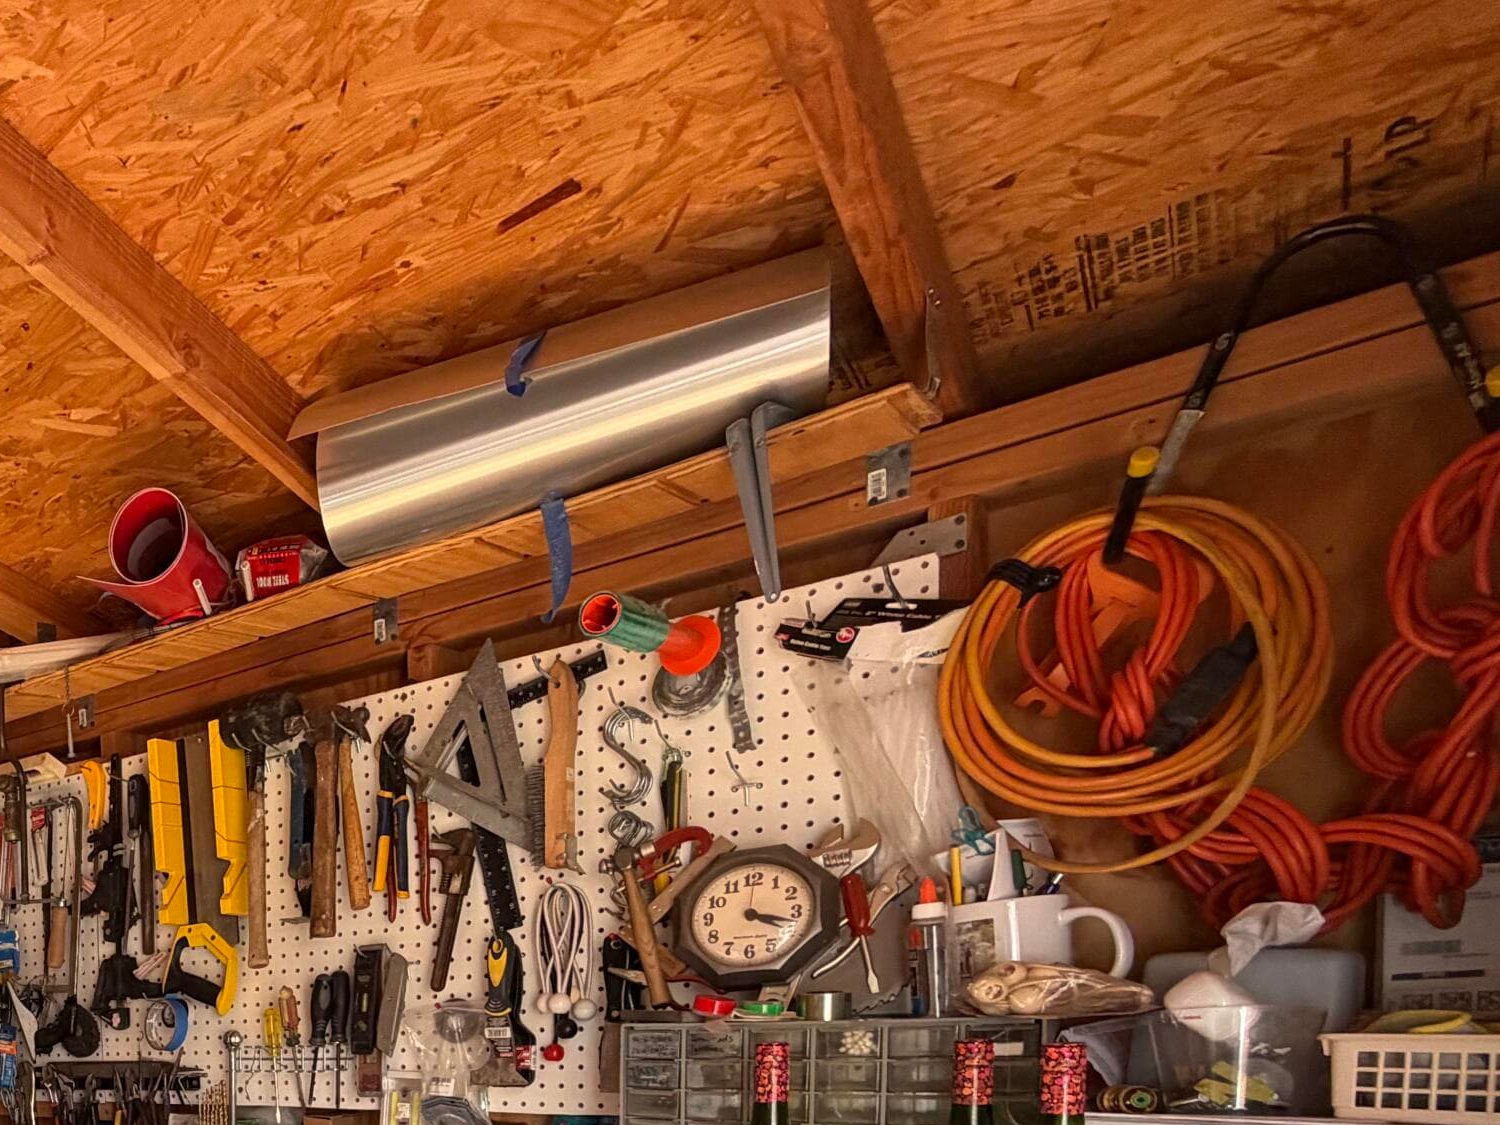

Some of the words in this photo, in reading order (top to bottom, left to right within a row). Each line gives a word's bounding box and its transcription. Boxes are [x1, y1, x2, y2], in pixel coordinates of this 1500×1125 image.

[723, 879, 740, 894] 11
[743, 871, 764, 888] 12
[771, 875, 780, 890] 1
[784, 885, 798, 901] 2
[708, 895, 727, 909] 10
[790, 903, 803, 919] 3
[703, 912, 714, 927] 9
[707, 929, 719, 944] 8
[722, 941, 735, 956] 7
[743, 944, 756, 959] 6
[765, 937, 777, 953] 5
